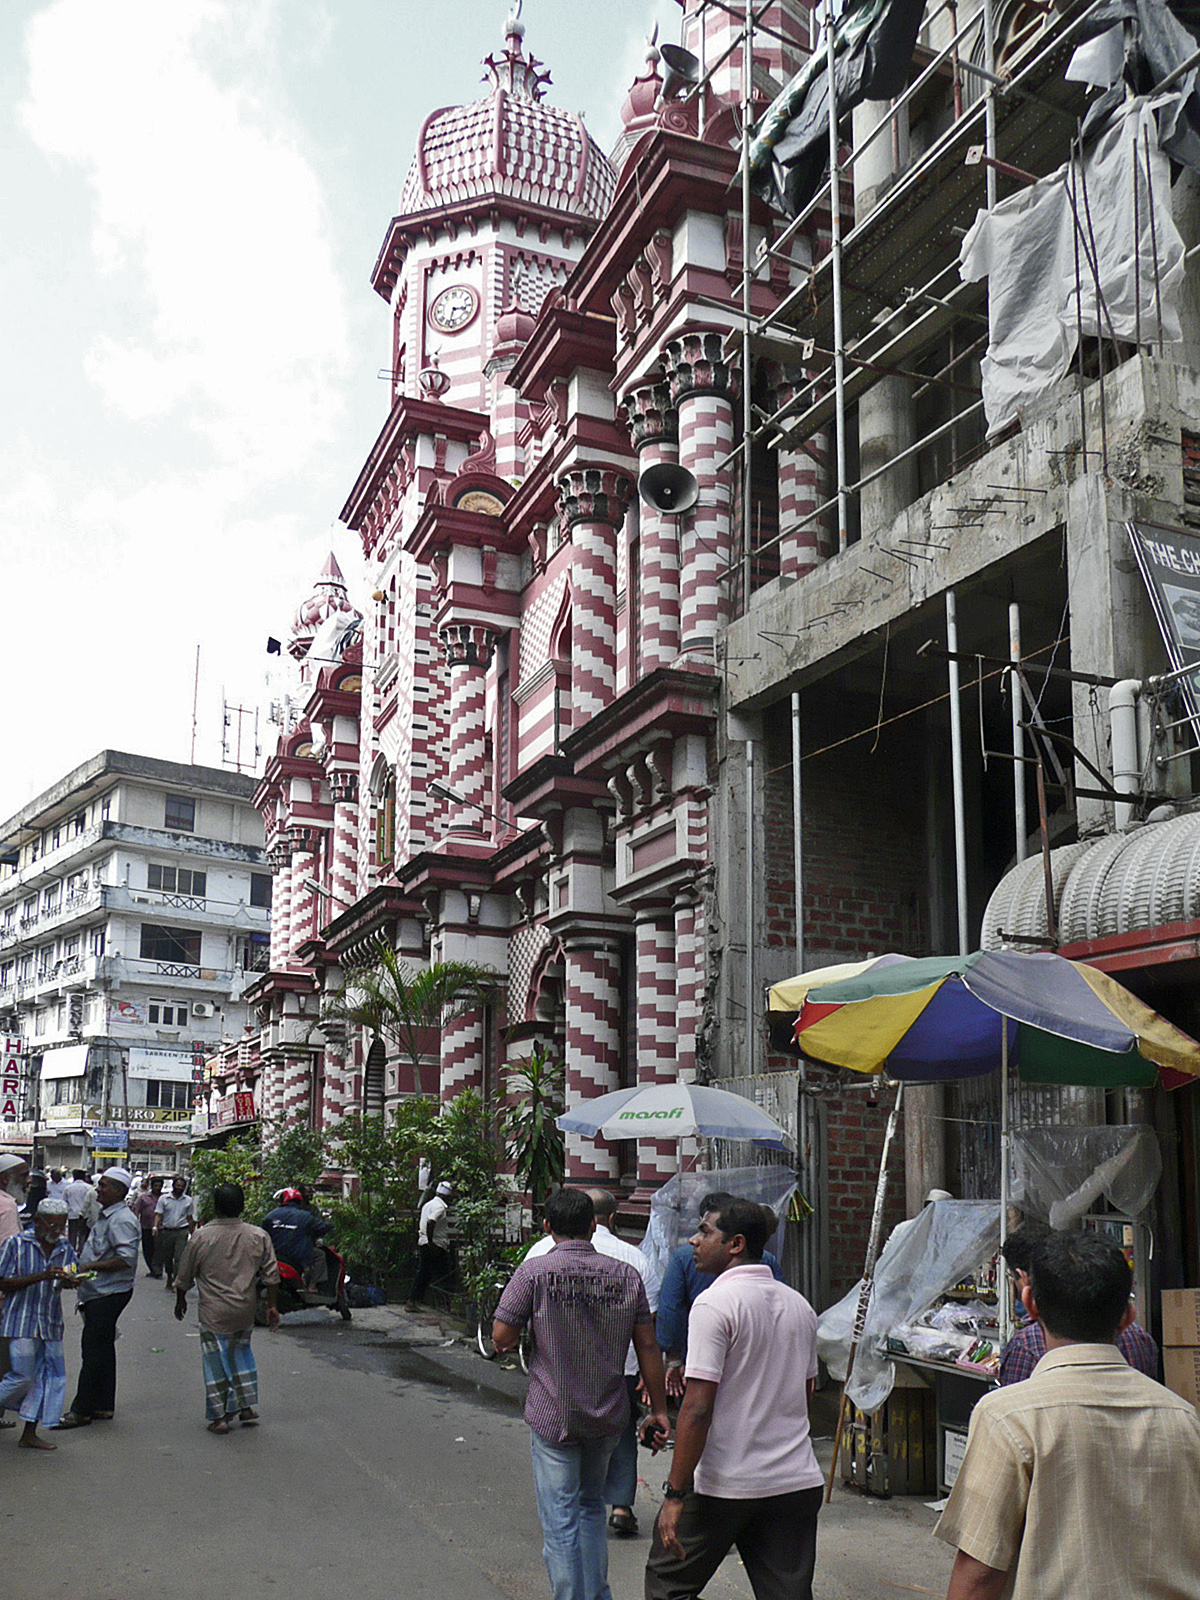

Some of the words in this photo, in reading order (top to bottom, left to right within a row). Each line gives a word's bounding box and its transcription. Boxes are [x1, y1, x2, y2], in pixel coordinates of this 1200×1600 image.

[1144, 540, 1181, 570] THE
[2, 1038, 21, 1115] HARA
[192, 1042, 203, 1095] THAJ
[112, 1107, 155, 1120] HERO
[619, 1107, 685, 1120] masafi
[121, 1121, 185, 1134] ENTERPRIS
